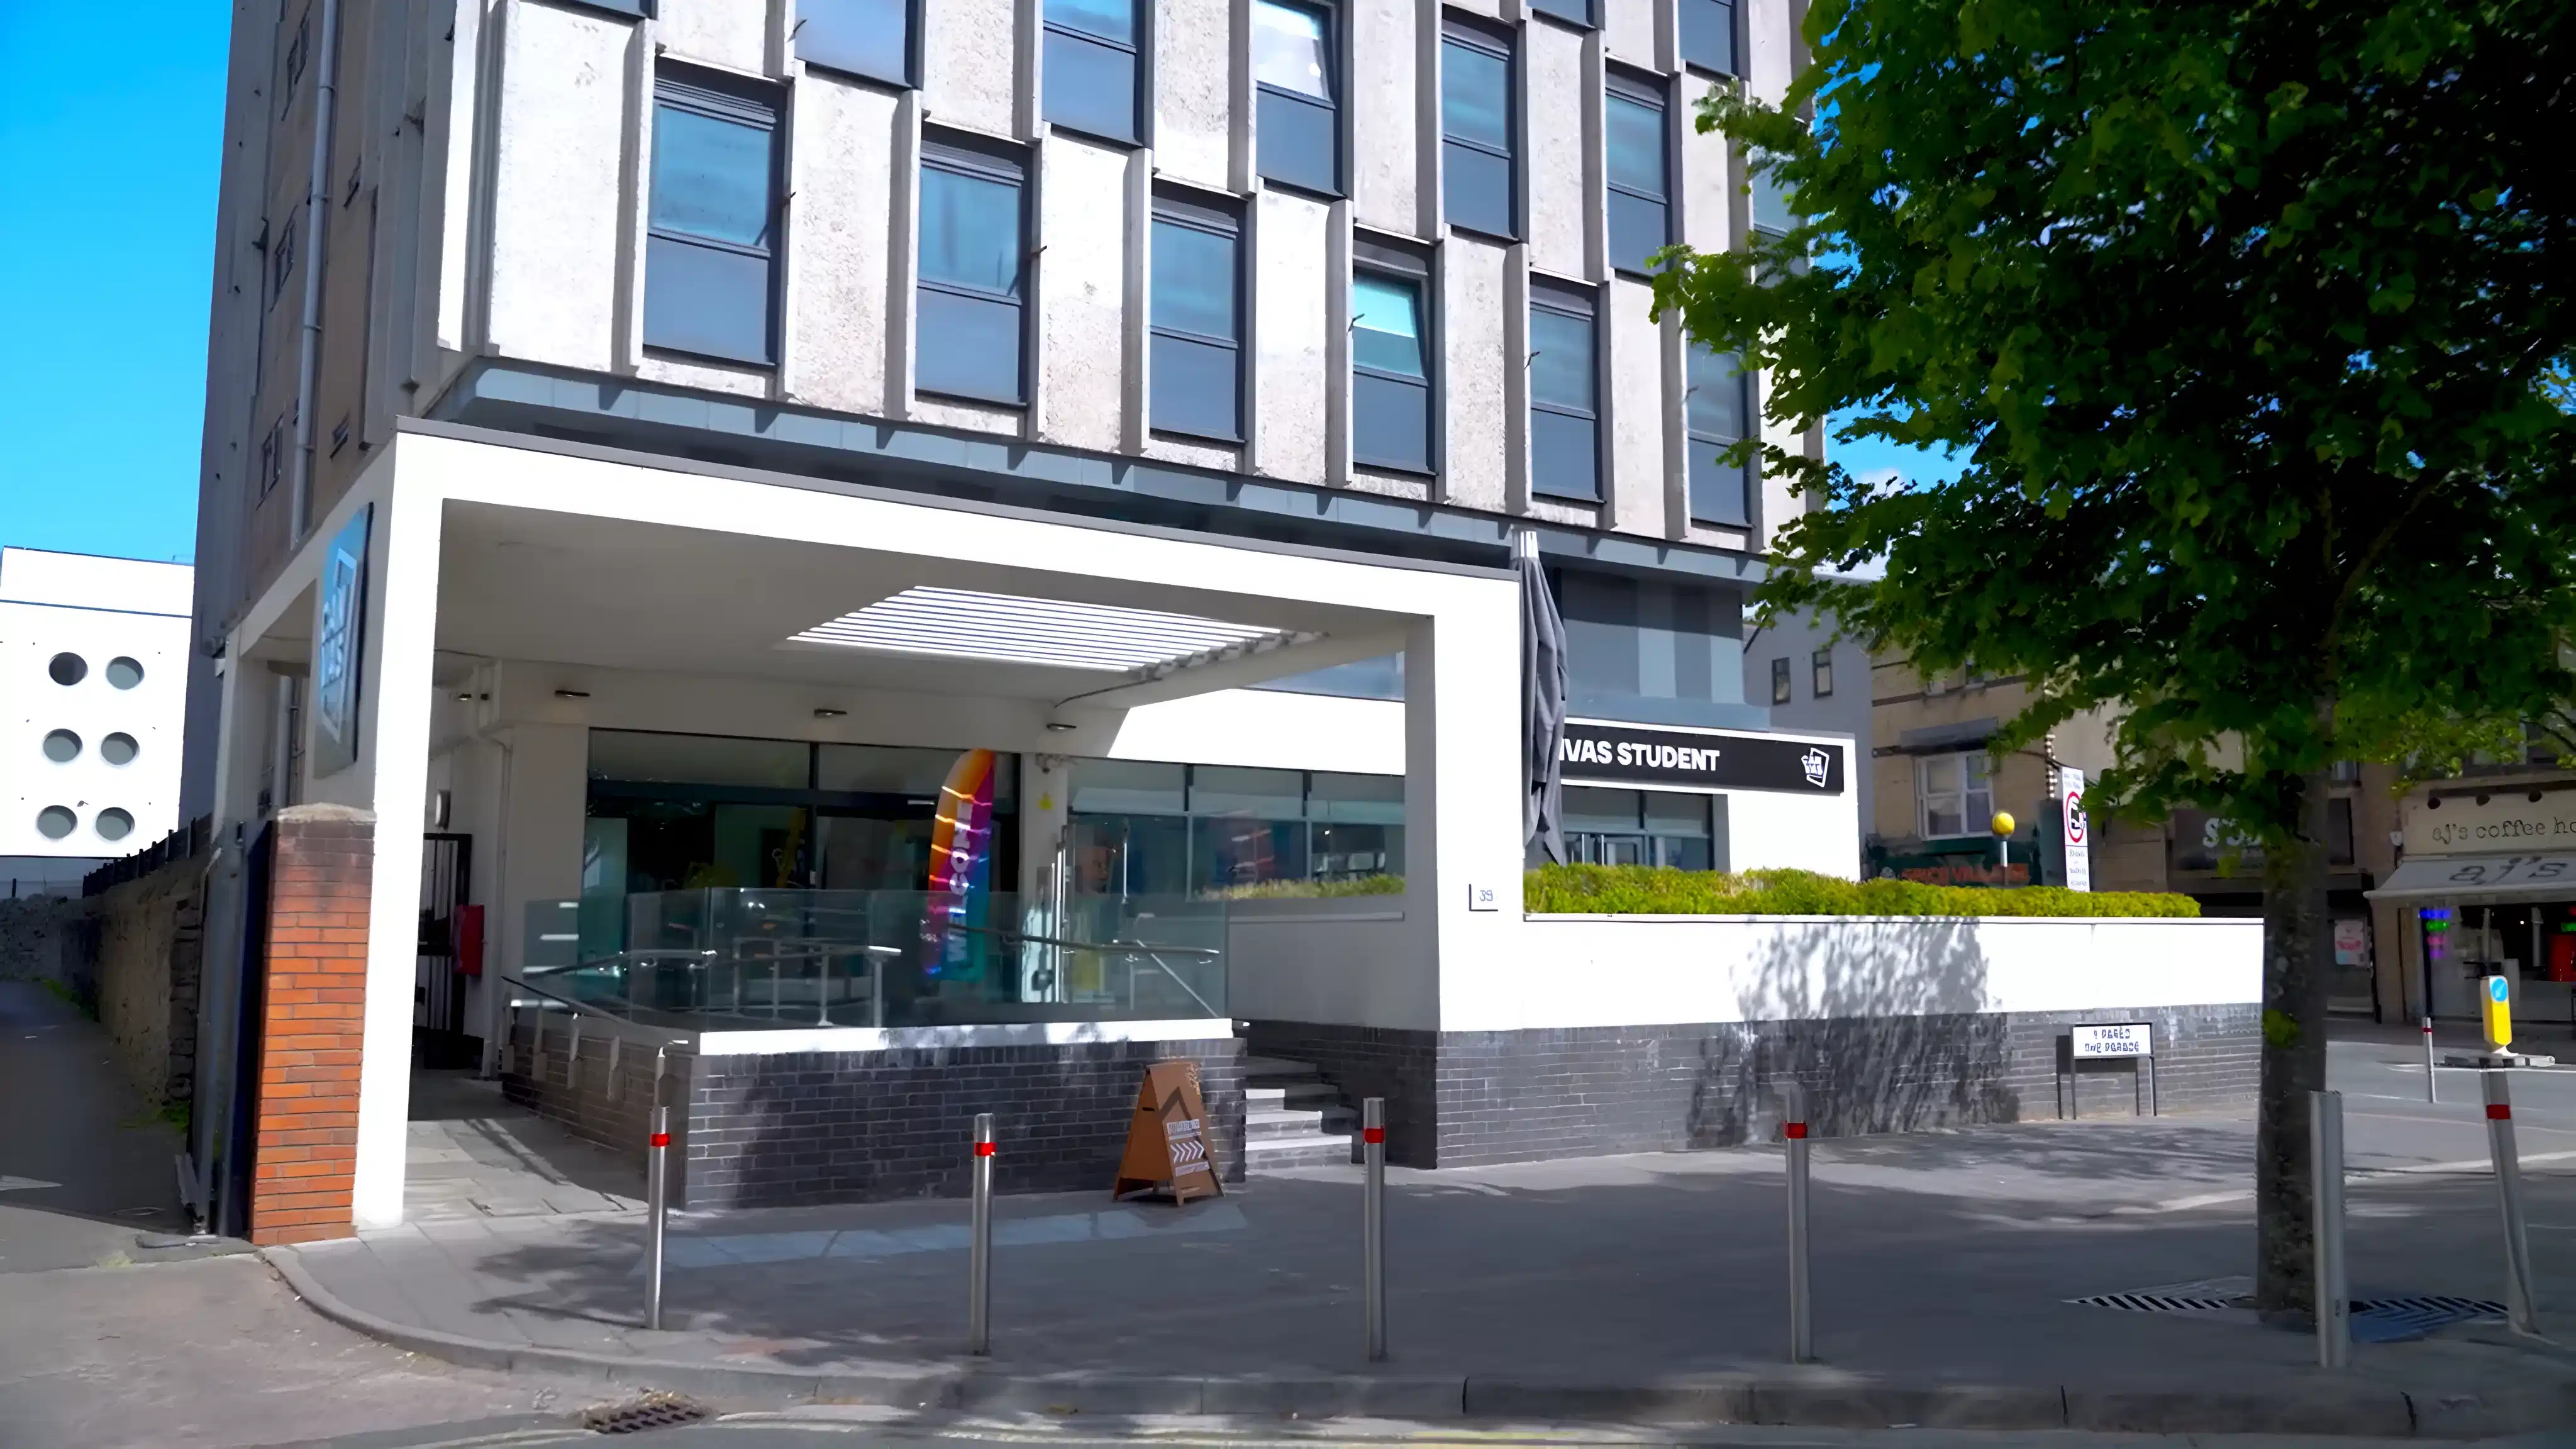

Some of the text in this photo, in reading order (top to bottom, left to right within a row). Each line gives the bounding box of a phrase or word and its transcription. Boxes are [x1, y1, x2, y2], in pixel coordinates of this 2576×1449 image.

[1617, 743, 1720, 770] STUDENT
[2476, 819, 2546, 838] coffee
[2450, 856, 2568, 885] aj's
